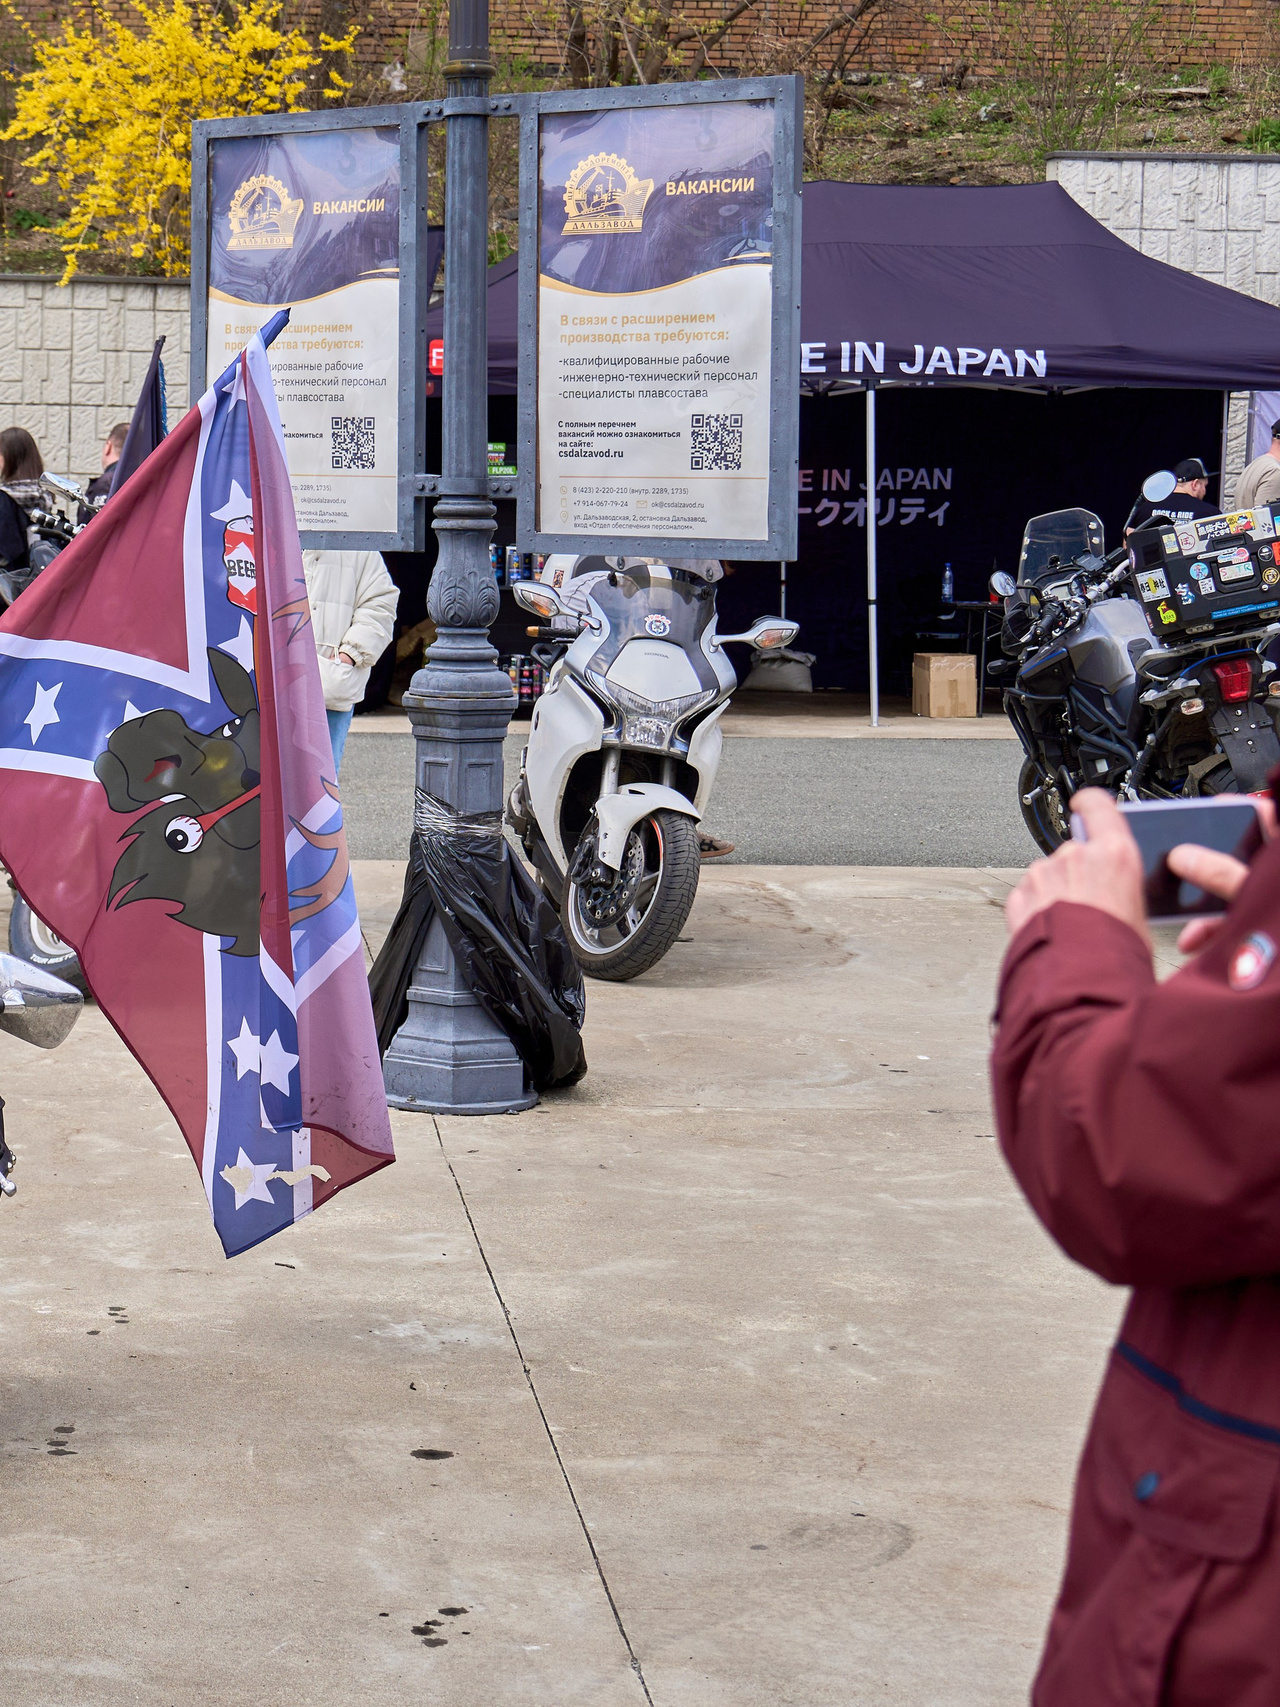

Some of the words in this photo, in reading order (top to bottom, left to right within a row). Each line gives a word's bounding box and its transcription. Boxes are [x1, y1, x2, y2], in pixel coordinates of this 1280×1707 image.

[665, 177, 755, 196] ВАКАНСИИ
[313, 198, 385, 215] ВАКАНСИИ
[572, 220, 634, 230] ДАЛЬЗАВОД
[236, 237, 287, 246] ДАЛЬЗАВОД
[560, 315, 569, 326] В
[572, 315, 608, 326] связи
[611, 315, 618, 325] с
[621, 313, 716, 328] расширением
[225, 324, 232, 334] В
[282, 323, 353, 335] асширением
[560, 332, 650, 346] производства
[654, 329, 729, 345] требуются:
[301, 338, 364, 353] требуются:
[558, 355, 680, 368] -квалифицированные
[682, 353, 730, 367] рабочие
[840, 341, 885, 374] IN
[898, 344, 1047, 378] JAPAN
[324, 361, 364, 373] рабочие
[341, 377, 387, 388] персонал
[558, 370, 701, 384] -инженерно-технический
[703, 371, 758, 383] персонал
[287, 393, 345, 402] плавсостава
[558, 388, 635, 400] -специалисты
[638, 388, 708, 399] плавсостава
[558, 420, 564, 428] С
[597, 421, 637, 429] перечнем
[558, 430, 595, 438] вакансий
[569, 440, 594, 448] сайте:
[558, 448, 624, 458] csdalzavod.ru
[822, 468, 851, 491] IN
[572, 486, 577, 494] 8
[578, 486, 594, 494] (423)
[651, 501, 705, 509] ok@csdalzavod.ru
[644, 651, 670, 659] HONDA
